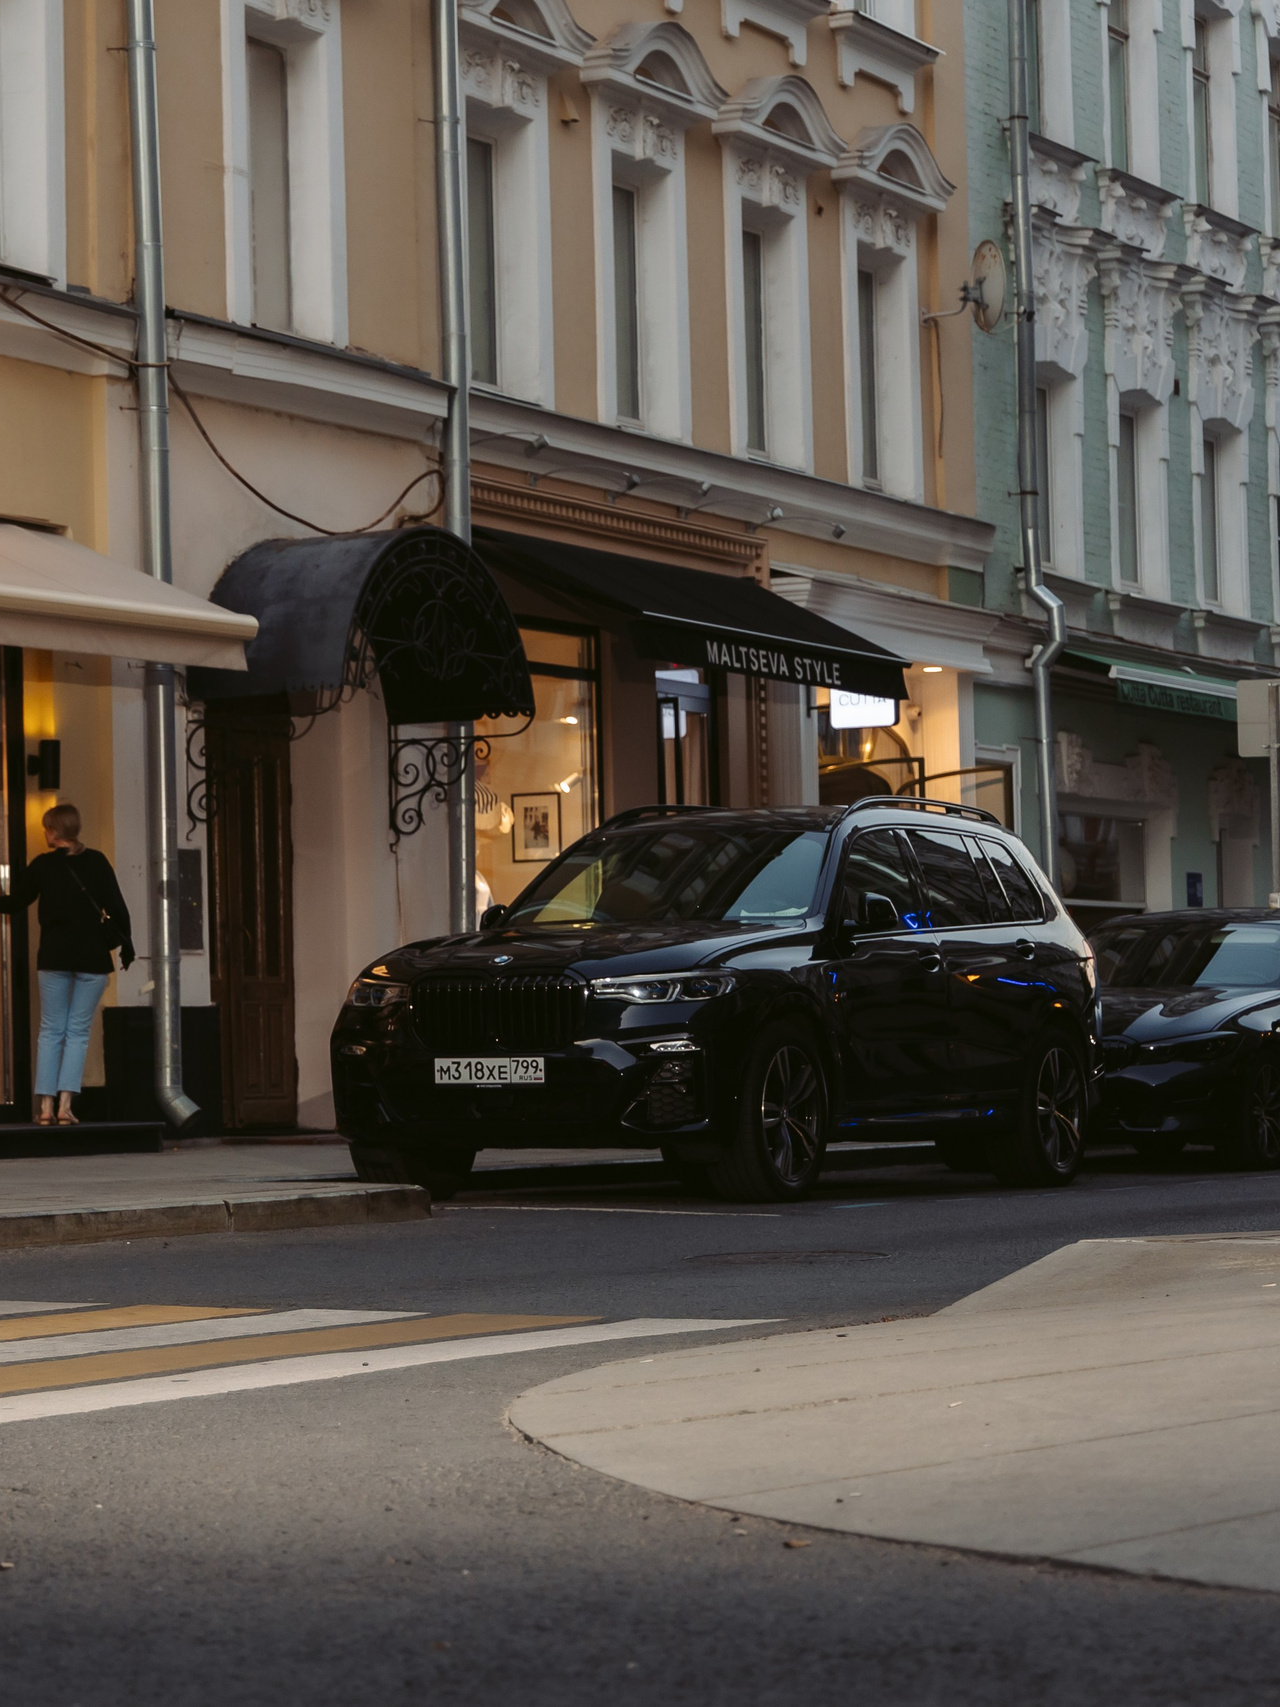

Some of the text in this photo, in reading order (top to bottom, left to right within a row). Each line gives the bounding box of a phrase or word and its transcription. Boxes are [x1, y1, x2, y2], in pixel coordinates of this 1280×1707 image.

[706, 640, 842, 685] MALTSEVA STYLE
[511, 1059, 539, 1075] 799
